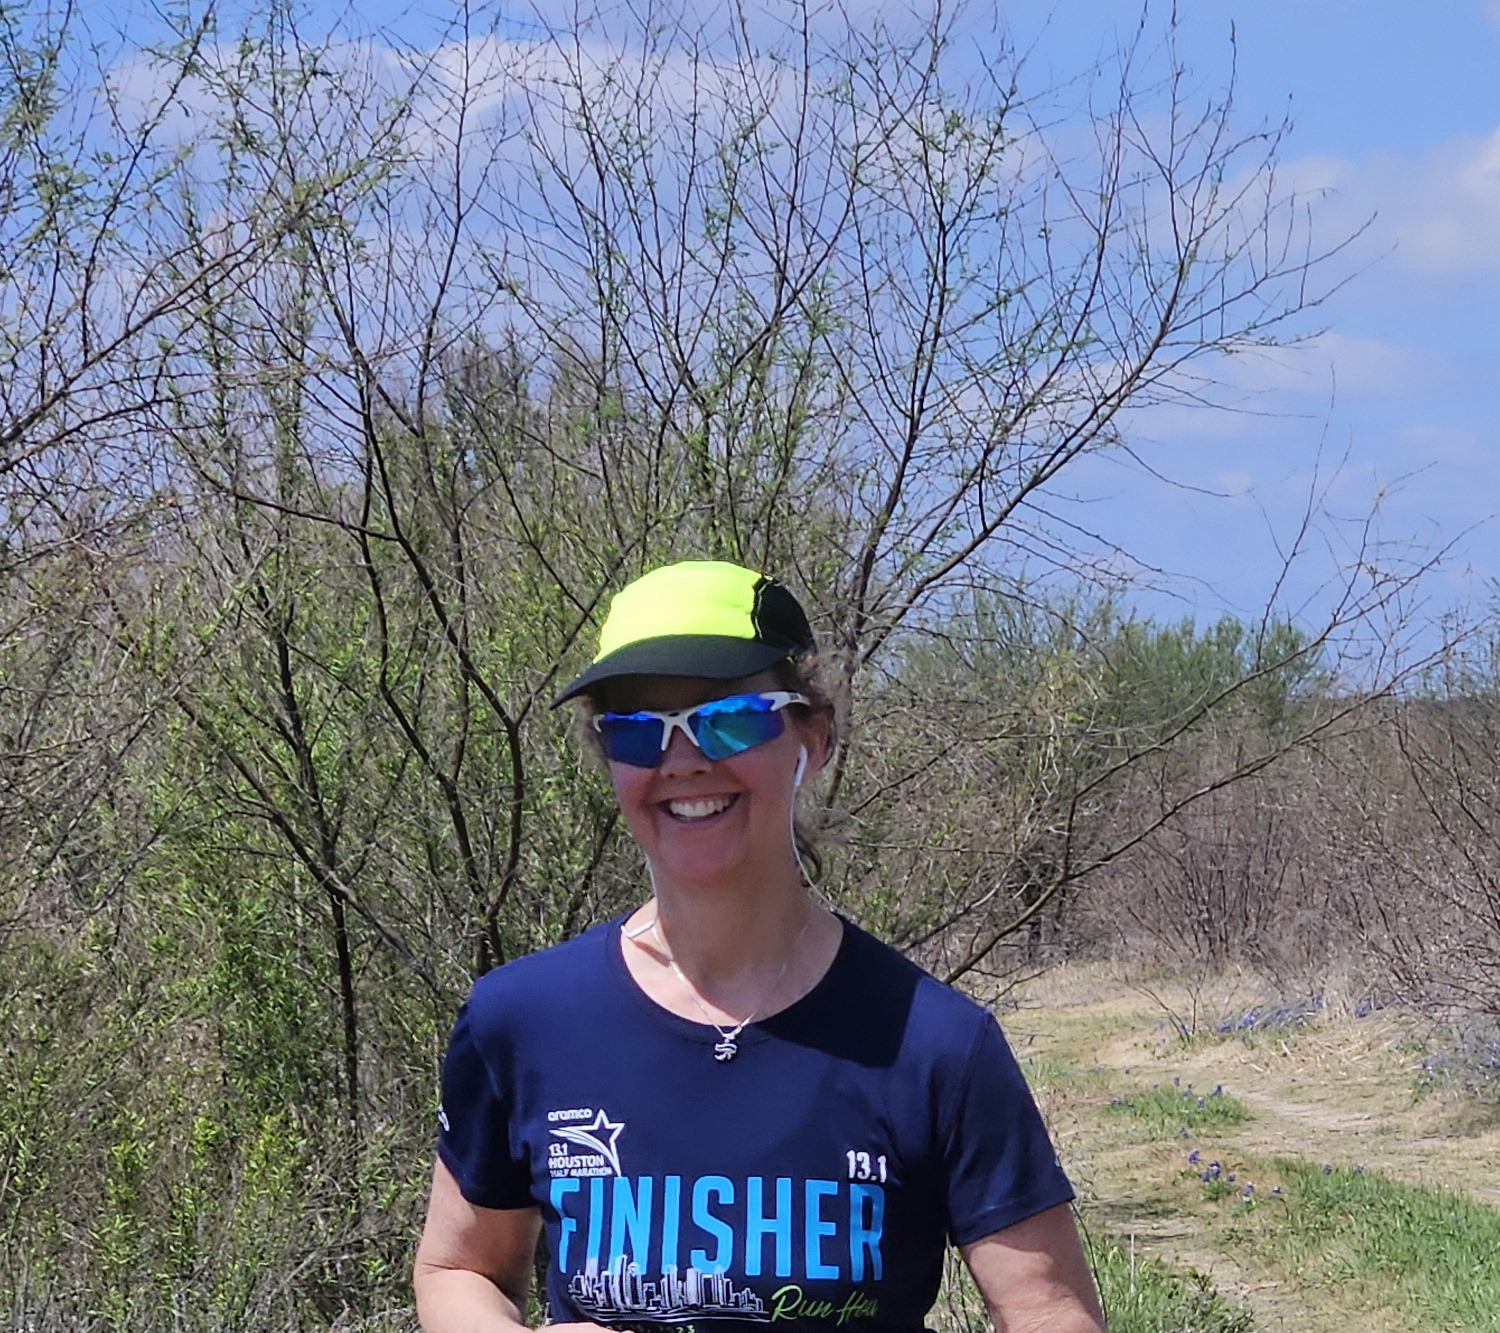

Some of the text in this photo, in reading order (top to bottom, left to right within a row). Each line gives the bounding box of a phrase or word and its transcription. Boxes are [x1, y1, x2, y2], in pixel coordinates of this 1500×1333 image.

[547, 1108, 593, 1121] aramco
[548, 1142, 568, 1157] 13.1
[548, 1154, 605, 1169] HOUSTON
[846, 1150, 887, 1183] 13.1
[550, 1175, 885, 1283] FINISHER
[770, 1284, 834, 1323] Run
